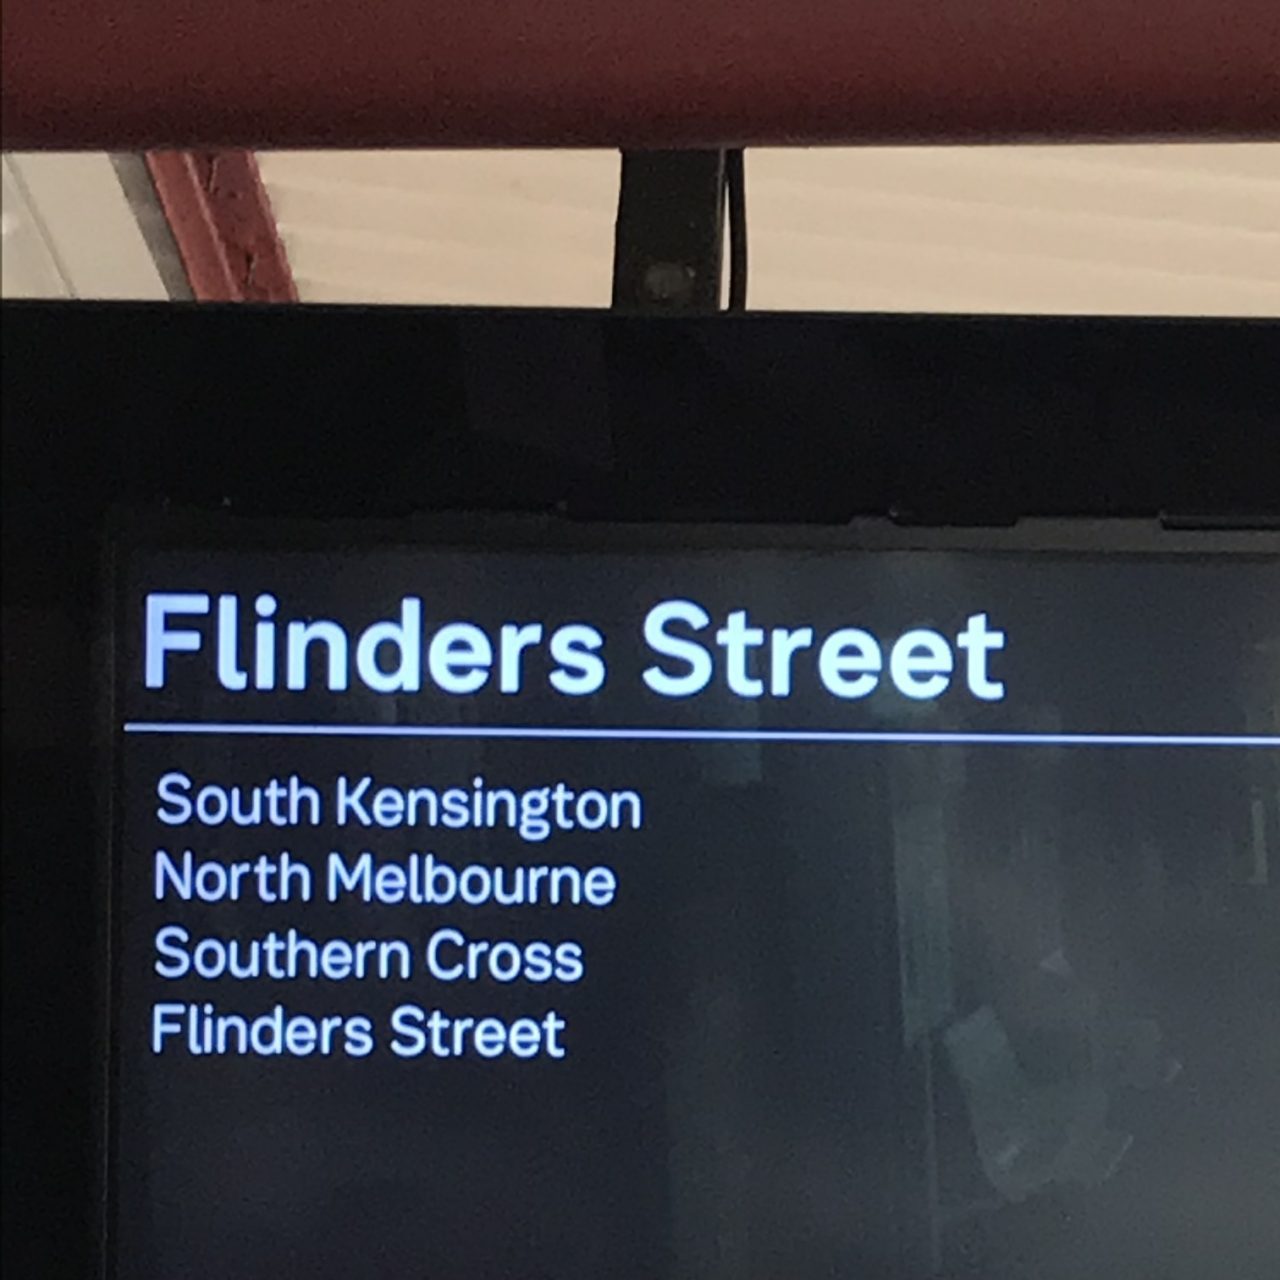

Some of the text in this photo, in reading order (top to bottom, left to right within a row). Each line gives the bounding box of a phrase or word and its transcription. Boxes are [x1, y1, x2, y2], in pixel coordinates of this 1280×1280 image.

[145, 594, 1004, 700] Flinders Street
[157, 772, 641, 841] South Kensington
[155, 850, 616, 906] North Melbourne
[155, 926, 584, 982] Southern Cross
[153, 1003, 565, 1058] Flinders Street
